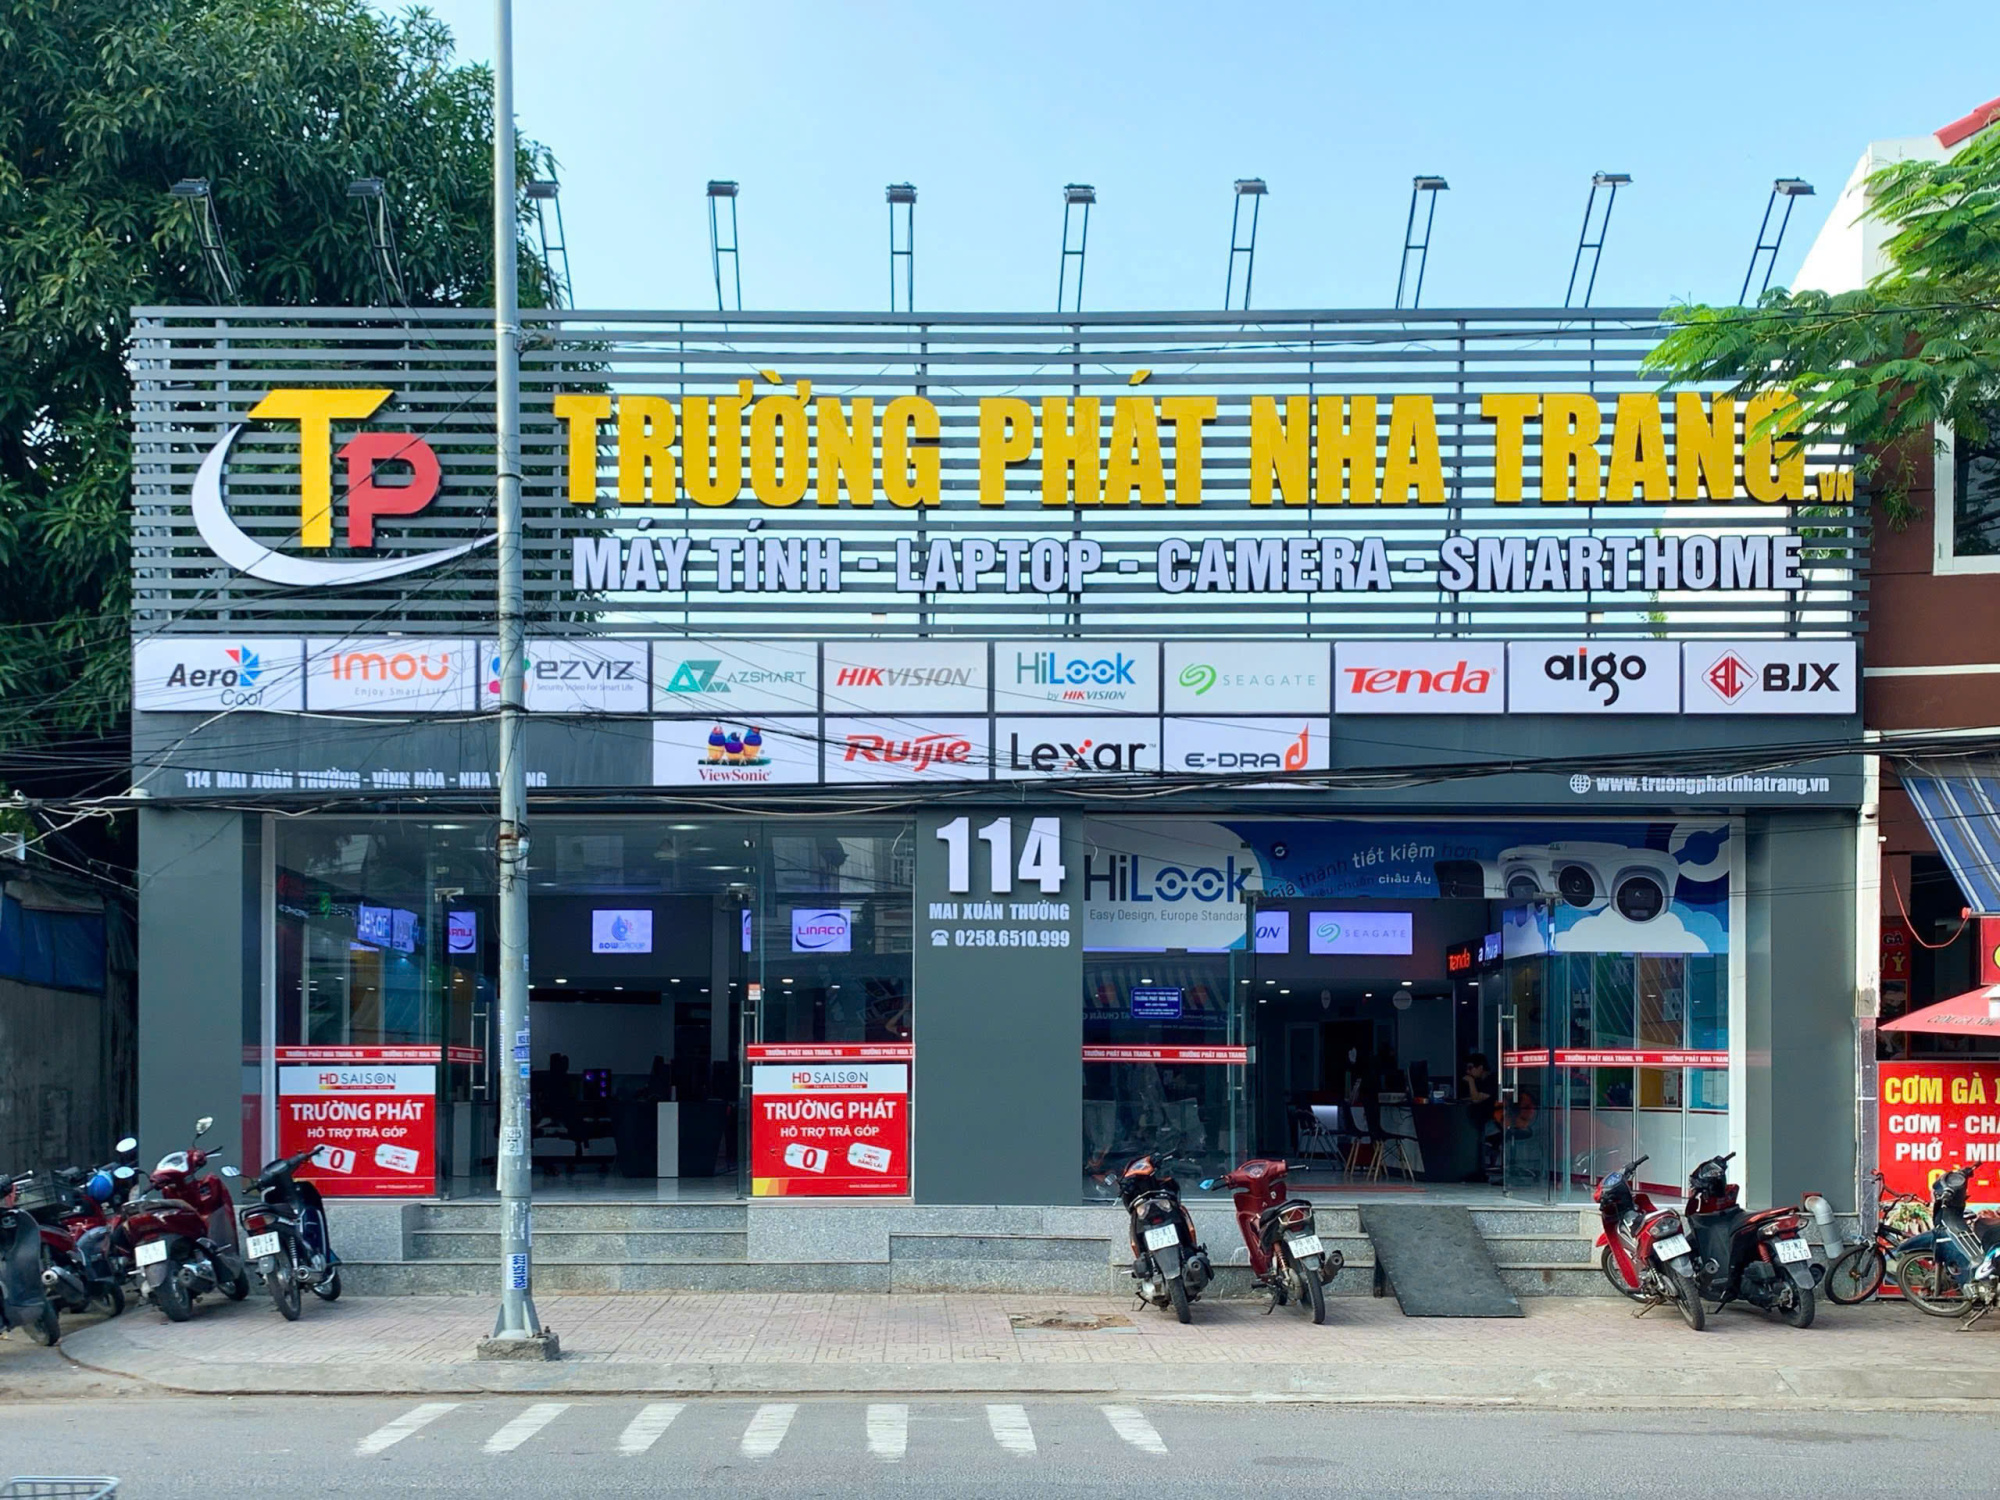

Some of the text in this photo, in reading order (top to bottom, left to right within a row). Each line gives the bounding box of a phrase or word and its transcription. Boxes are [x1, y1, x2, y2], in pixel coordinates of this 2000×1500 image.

[554, 370, 941, 508] TRƯỜNG
[979, 369, 1217, 506] PHÁT
[1250, 395, 1446, 504] NHA
[572, 518, 691, 592] MÁY
[710, 518, 842, 593] TÍNH
[895, 537, 1101, 594] LAPTOP
[1156, 536, 1393, 593] CAMERA
[166, 663, 238, 688] Aero
[727, 671, 806, 684] AZSMART
[836, 666, 972, 687] HIKVISION
[1016, 651, 1136, 685] HiLook
[1344, 660, 1492, 695] Tenda
[1544, 647, 1647, 707] aigo
[1762, 662, 1840, 693] BJX
[1223, 674, 1316, 687] SEAGATE
[221, 688, 264, 706] Cool
[354, 686, 384, 697] Enjoy
[1046, 689, 1127, 702] by HIKVISION
[844, 732, 972, 774] Ruijie
[1010, 732, 1146, 773] Lexar
[185, 771, 211, 789] 114
[217, 771, 247, 788] MAI
[251, 767, 293, 788] XUÂN
[414, 766, 446, 788] HÒA
[459, 772, 491, 788] NHA
[698, 767, 770, 782] ViewSonic
[1596, 775, 1830, 795] www.truongphatnhatrang.vn
[936, 816, 1066, 893] 114
[1352, 846, 1384, 869] tiết
[1390, 841, 1435, 863] kiệm
[1413, 871, 1431, 885] Âu
[929, 903, 958, 920] MAI
[962, 900, 1004, 920] XUÂN
[1089, 909, 1116, 924] Easy
[1118, 909, 1157, 924] Design,
[1161, 909, 1199, 924] Europe
[798, 925, 845, 936] LINACO
[954, 929, 1070, 947] 0258.6510.999
[1345, 929, 1407, 938] SEAGATE
[341, 1072, 396, 1084] SAISON
[814, 1071, 868, 1083] SAISON
[1885, 1072, 1987, 1105] CƠM GÀ
[290, 1099, 425, 1121] TRƯỜNG PHÁT
[763, 1098, 896, 1120] TRƯỜNG PHÁT
[328, 1127, 352, 1140] TRỢ
[381, 1125, 408, 1138] GÓP
[801, 1126, 826, 1139] TRỢ
[854, 1124, 879, 1137] GÓP
[1888, 1113, 1941, 1134] CƠM
[329, 1149, 345, 1169] 0
[802, 1148, 818, 1169] 0
[1895, 1137, 1943, 1161] PHỞ
